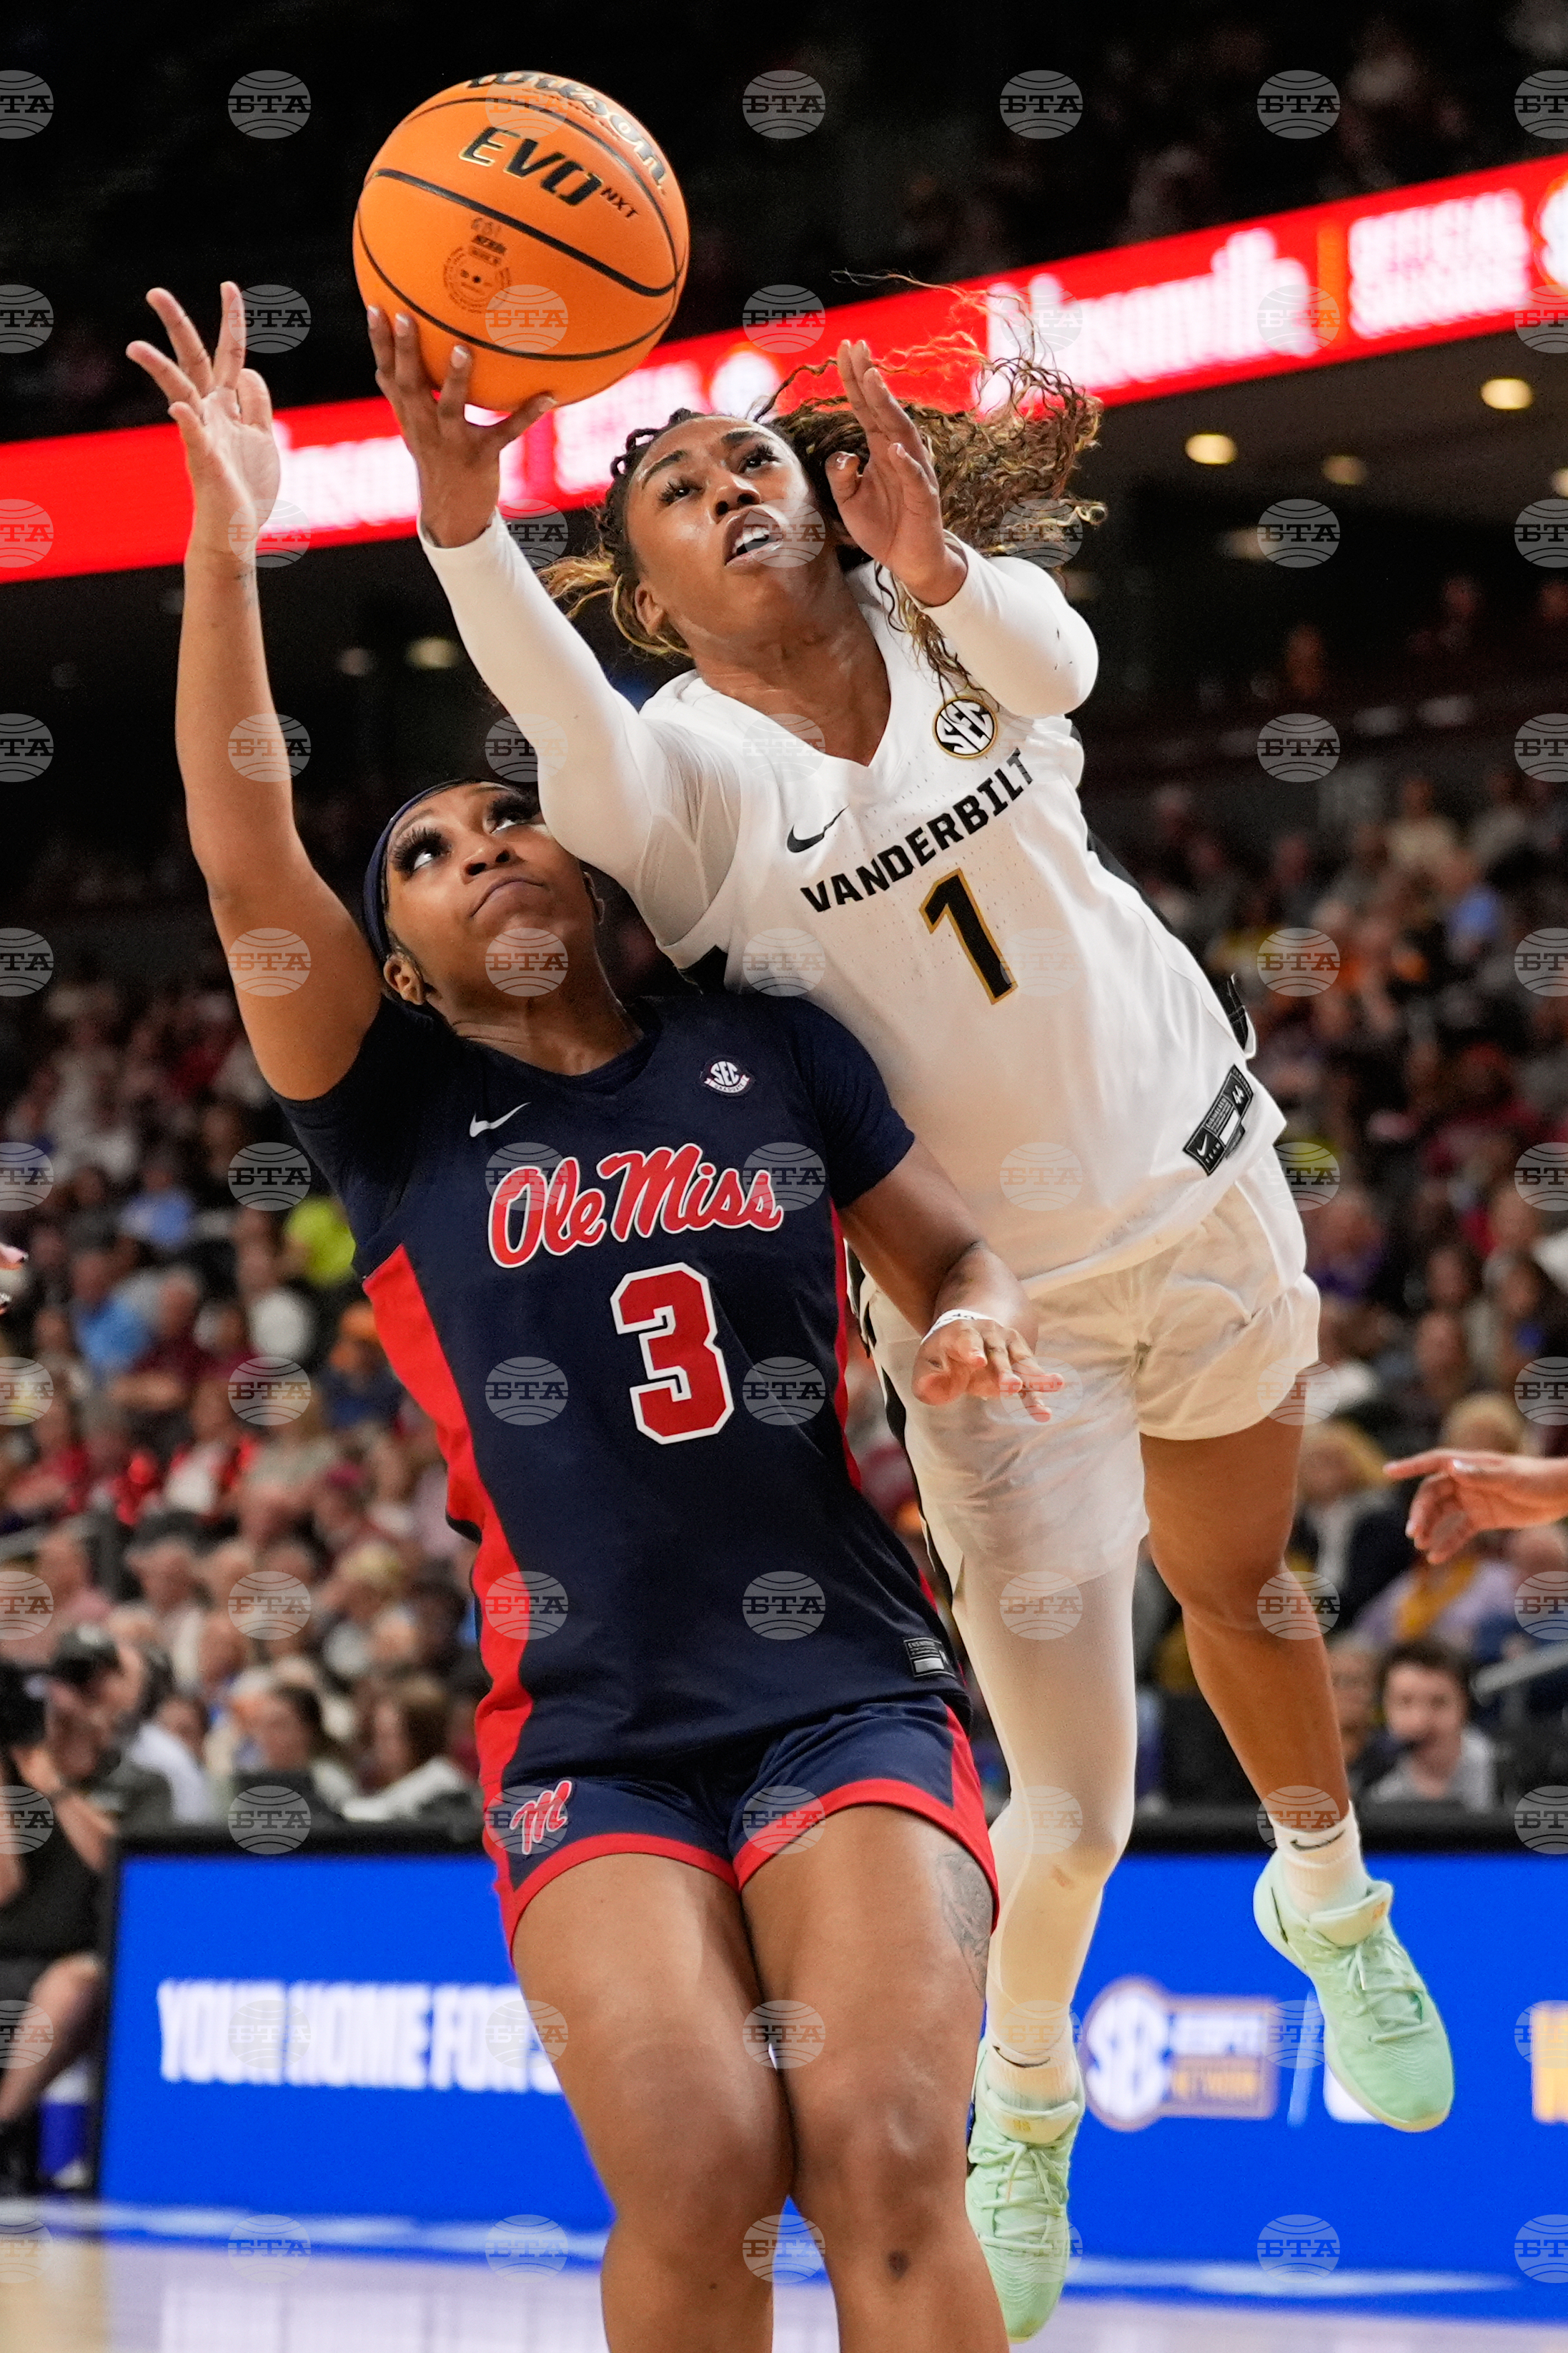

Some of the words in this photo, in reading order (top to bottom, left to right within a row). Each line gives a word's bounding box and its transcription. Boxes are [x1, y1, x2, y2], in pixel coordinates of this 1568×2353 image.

[458, 127, 603, 206] EVO
[600, 187, 639, 218] NXT
[936, 700, 993, 755] SEC
[800, 748, 1033, 913] VANDERBILT
[919, 867, 1018, 1005] 1
[710, 1061, 740, 1086] SEC
[488, 1156, 607, 1268] Ole
[597, 1144, 784, 1242] Miss
[610, 1262, 735, 1445] 3
